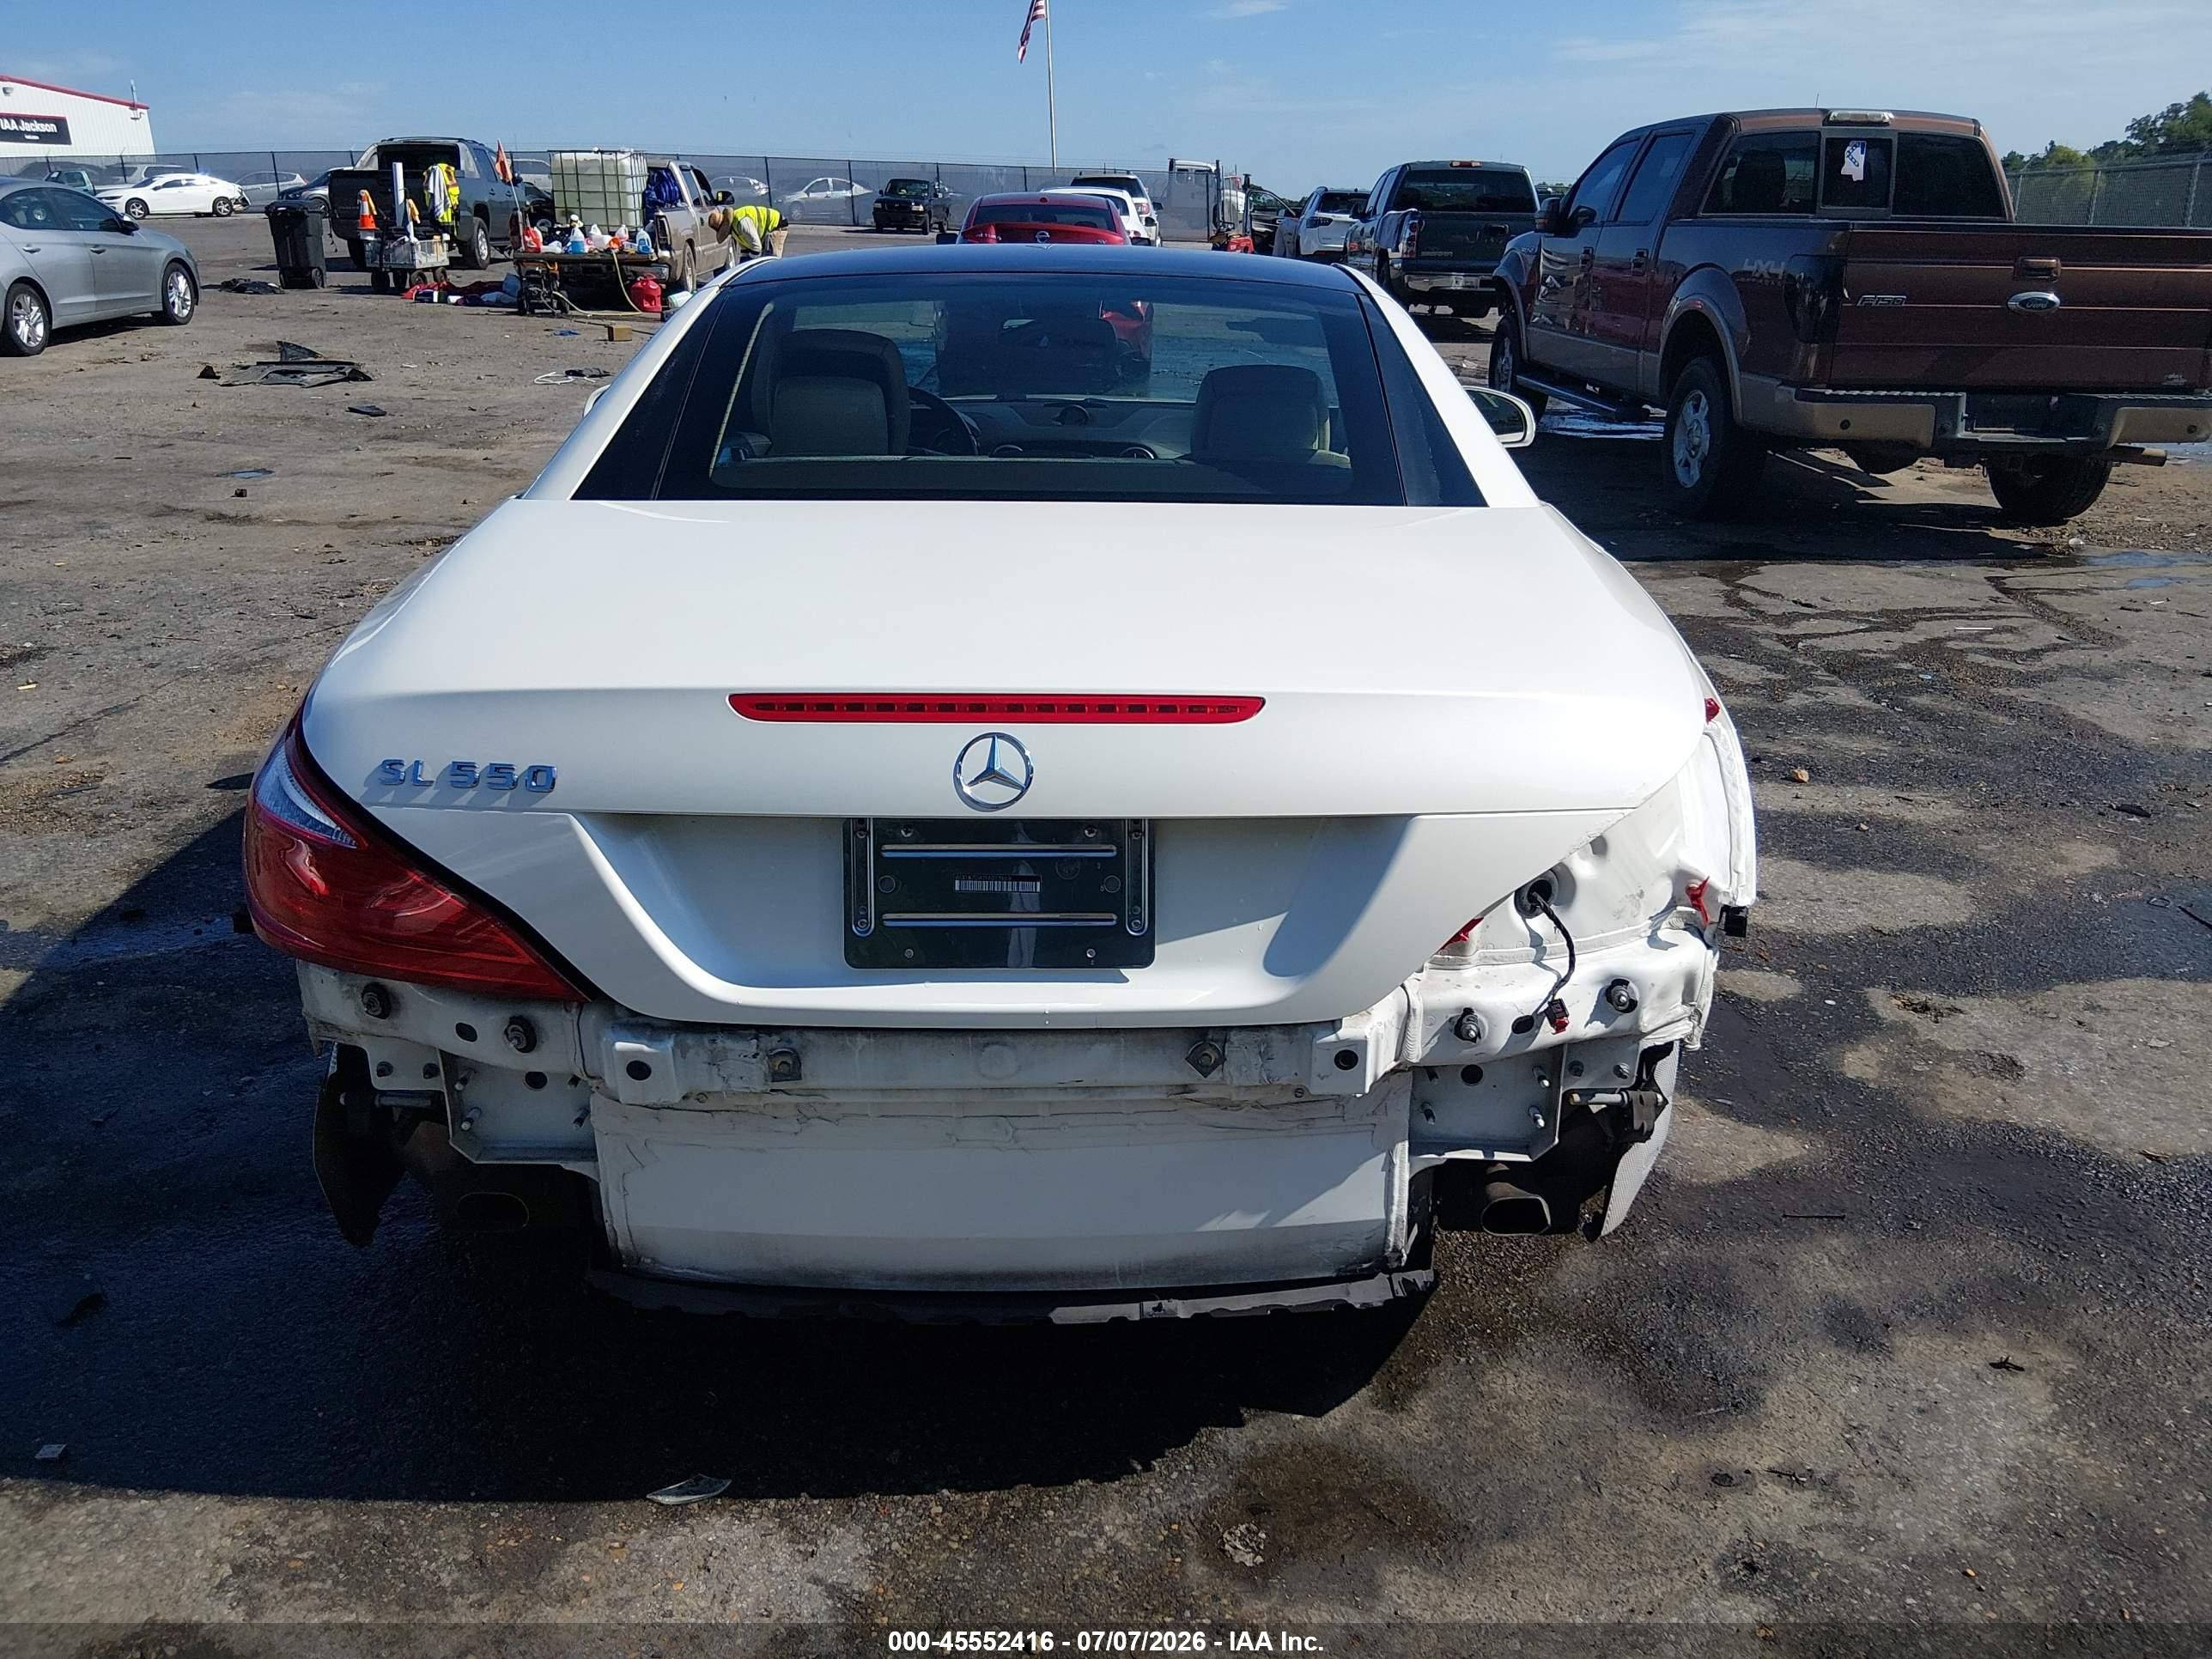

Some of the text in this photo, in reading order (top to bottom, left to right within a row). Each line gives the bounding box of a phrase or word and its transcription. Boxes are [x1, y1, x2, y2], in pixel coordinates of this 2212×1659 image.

[19, 119, 58, 133] Jackson
[379, 759, 557, 793] SL 550
